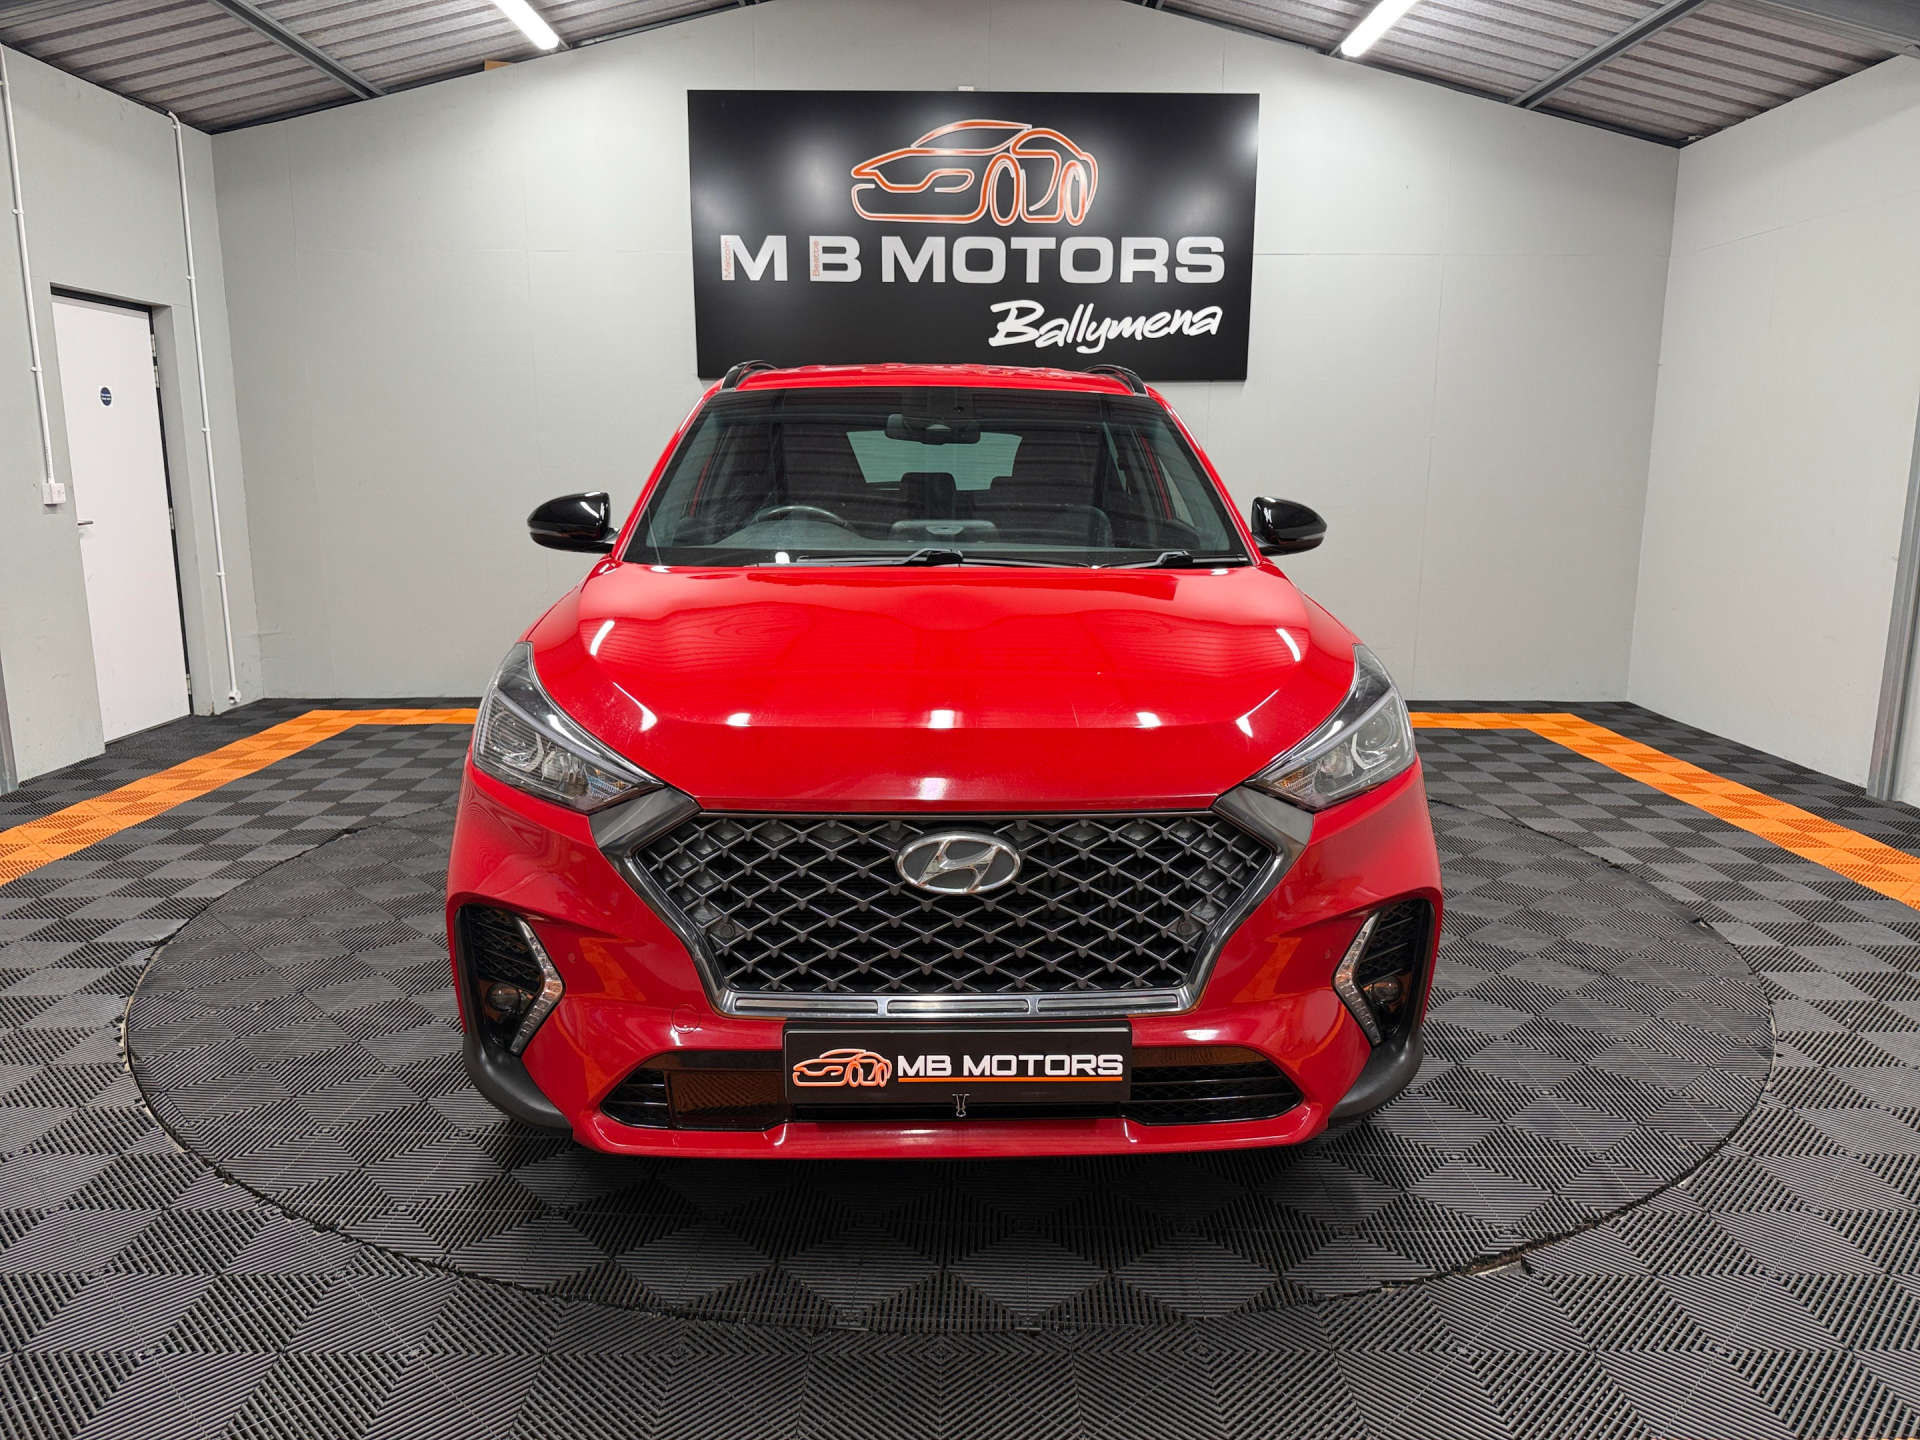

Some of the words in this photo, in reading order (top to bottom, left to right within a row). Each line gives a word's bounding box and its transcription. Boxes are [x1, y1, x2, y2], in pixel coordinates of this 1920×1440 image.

[720, 235, 788, 281] M
[809, 236, 862, 282] B
[881, 236, 1225, 284] MOTORS
[989, 300, 1223, 354] Ballymena
[897, 1055, 952, 1077] MB
[963, 1055, 1123, 1077] MOTORS
